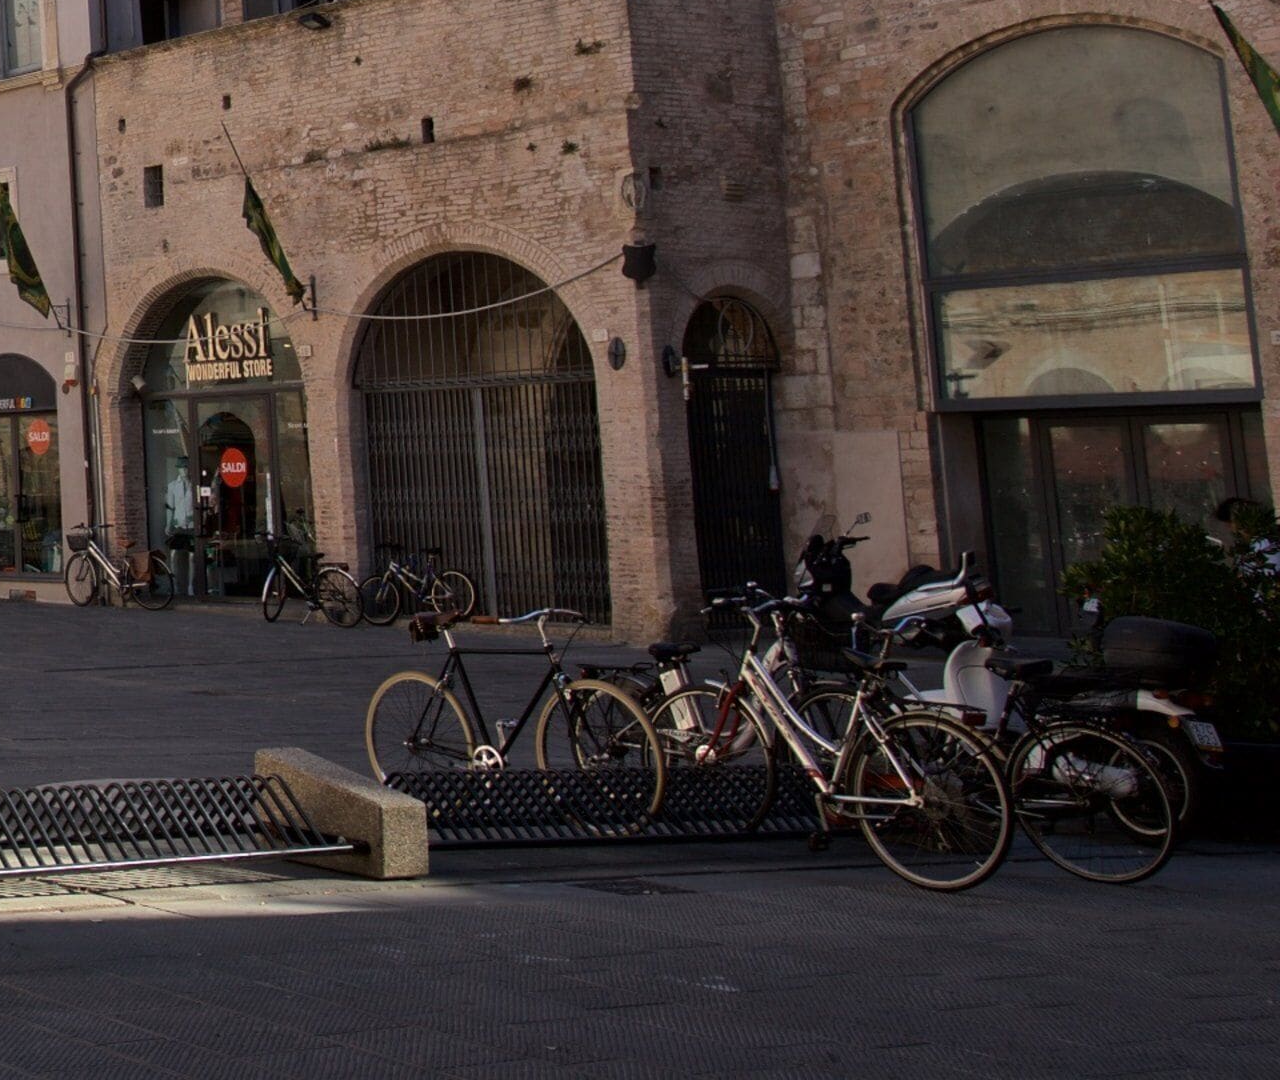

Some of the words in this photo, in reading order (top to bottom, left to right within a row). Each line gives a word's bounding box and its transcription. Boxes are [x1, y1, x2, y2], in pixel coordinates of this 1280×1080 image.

[183, 307, 267, 362] Alessi
[187, 361, 241, 380] WONDERFUL
[243, 358, 273, 377] STORE
[28, 431, 49, 442] SALDI
[221, 462, 246, 473] SALDI
